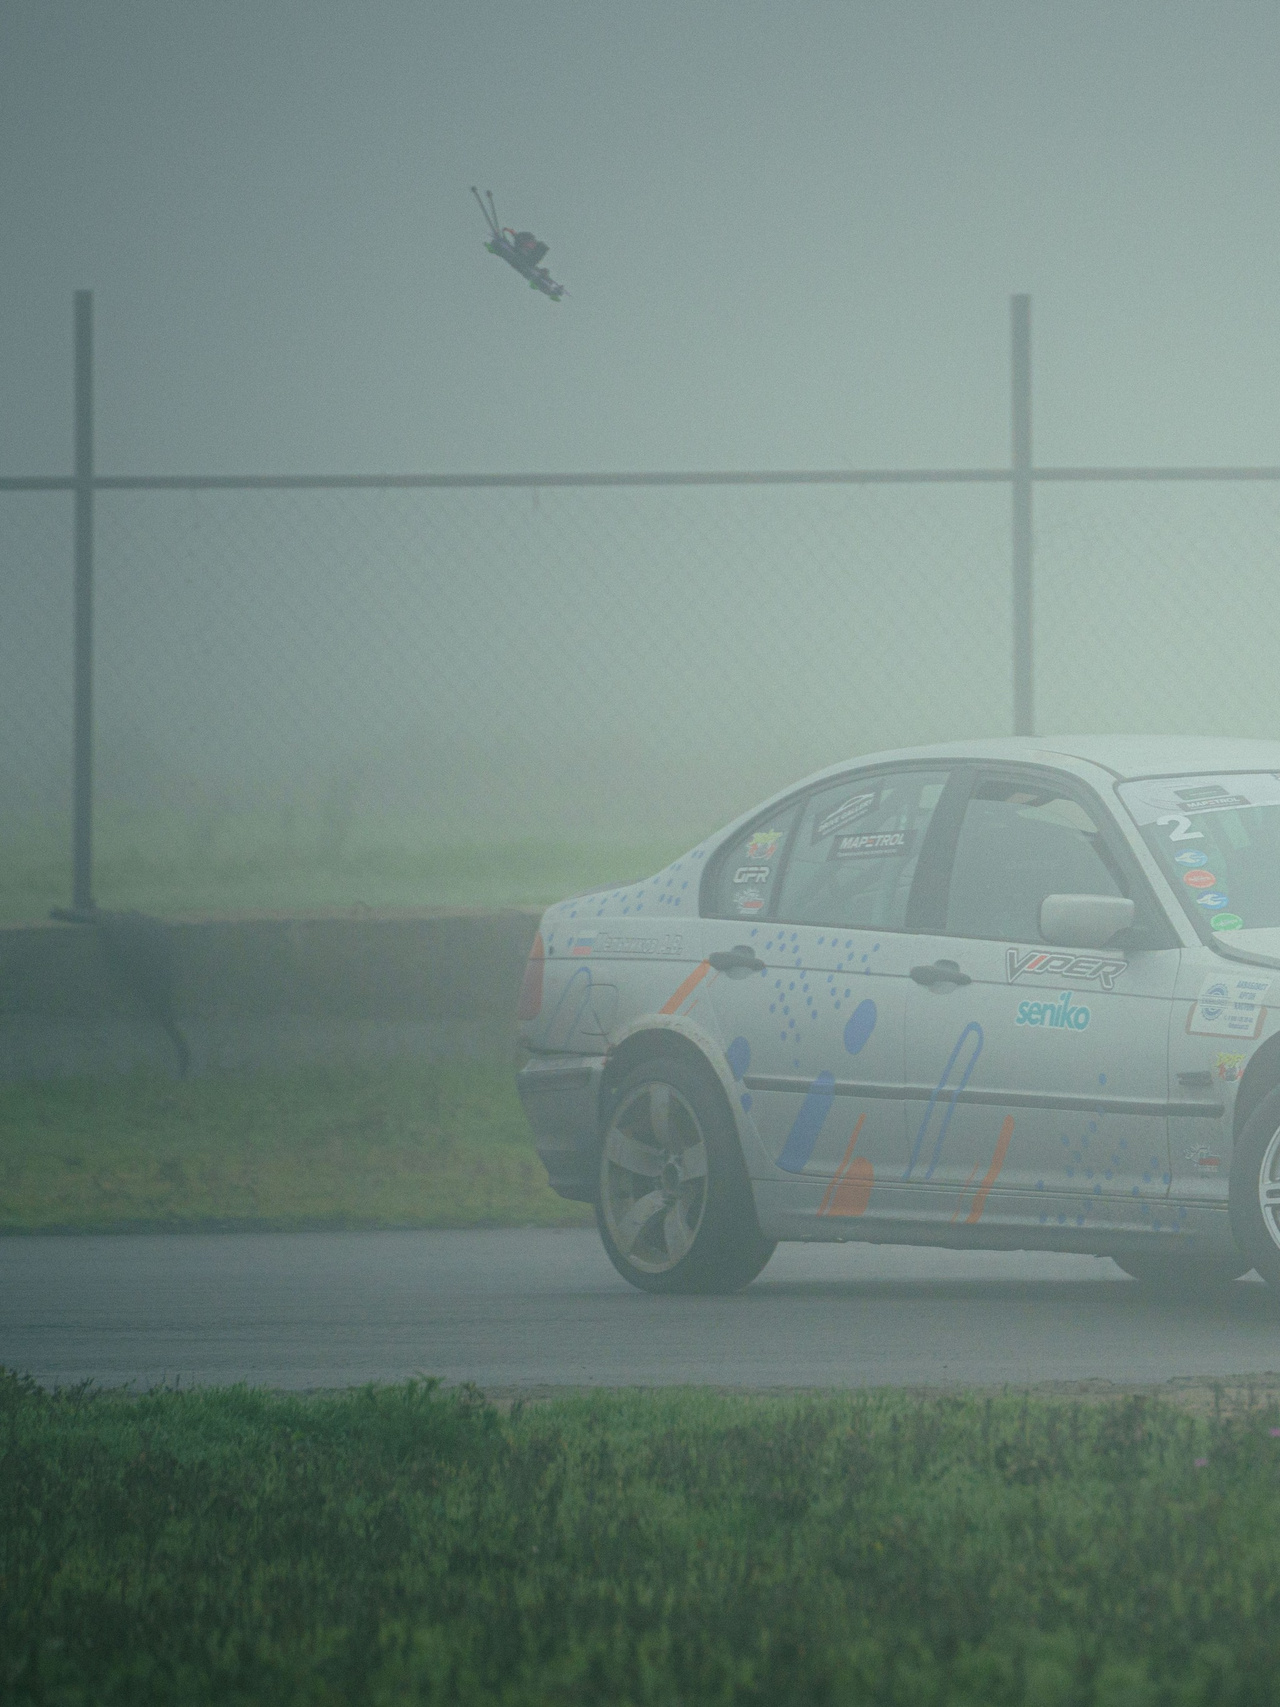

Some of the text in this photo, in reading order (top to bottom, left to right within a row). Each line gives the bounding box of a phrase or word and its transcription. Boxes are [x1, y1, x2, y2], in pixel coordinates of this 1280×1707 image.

[1186, 797, 1241, 809] MAPETROL
[839, 833, 905, 850] MAPETROL
[1156, 814, 1204, 842] 2
[1005, 947, 1128, 990] VIPER
[1015, 990, 1091, 1031] seniko
